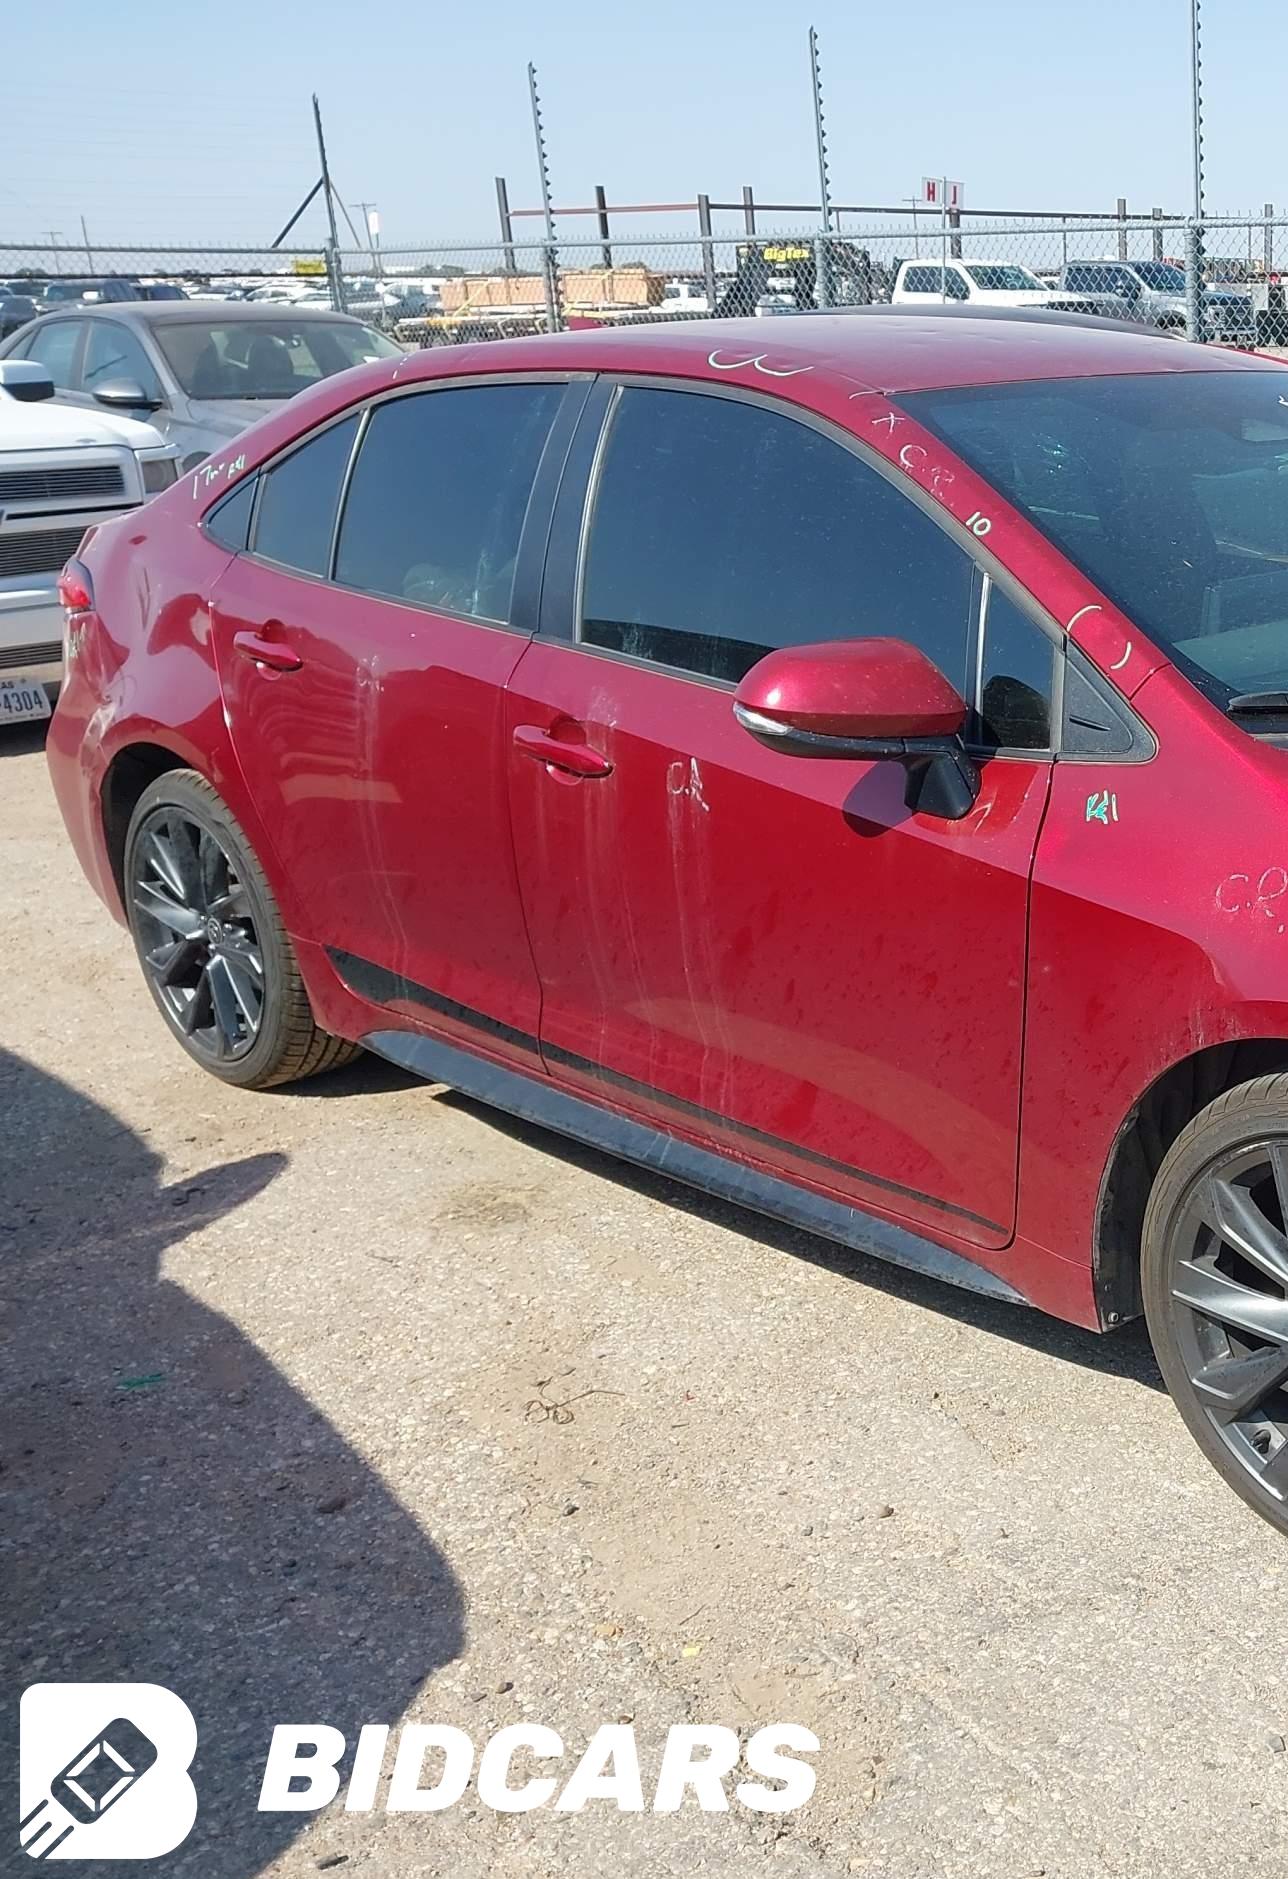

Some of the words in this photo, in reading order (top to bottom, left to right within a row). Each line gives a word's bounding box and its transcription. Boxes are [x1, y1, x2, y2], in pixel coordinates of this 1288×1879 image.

[926, 181, 936, 202] H
[951, 185, 958, 205] J
[965, 511, 992, 536] 10
